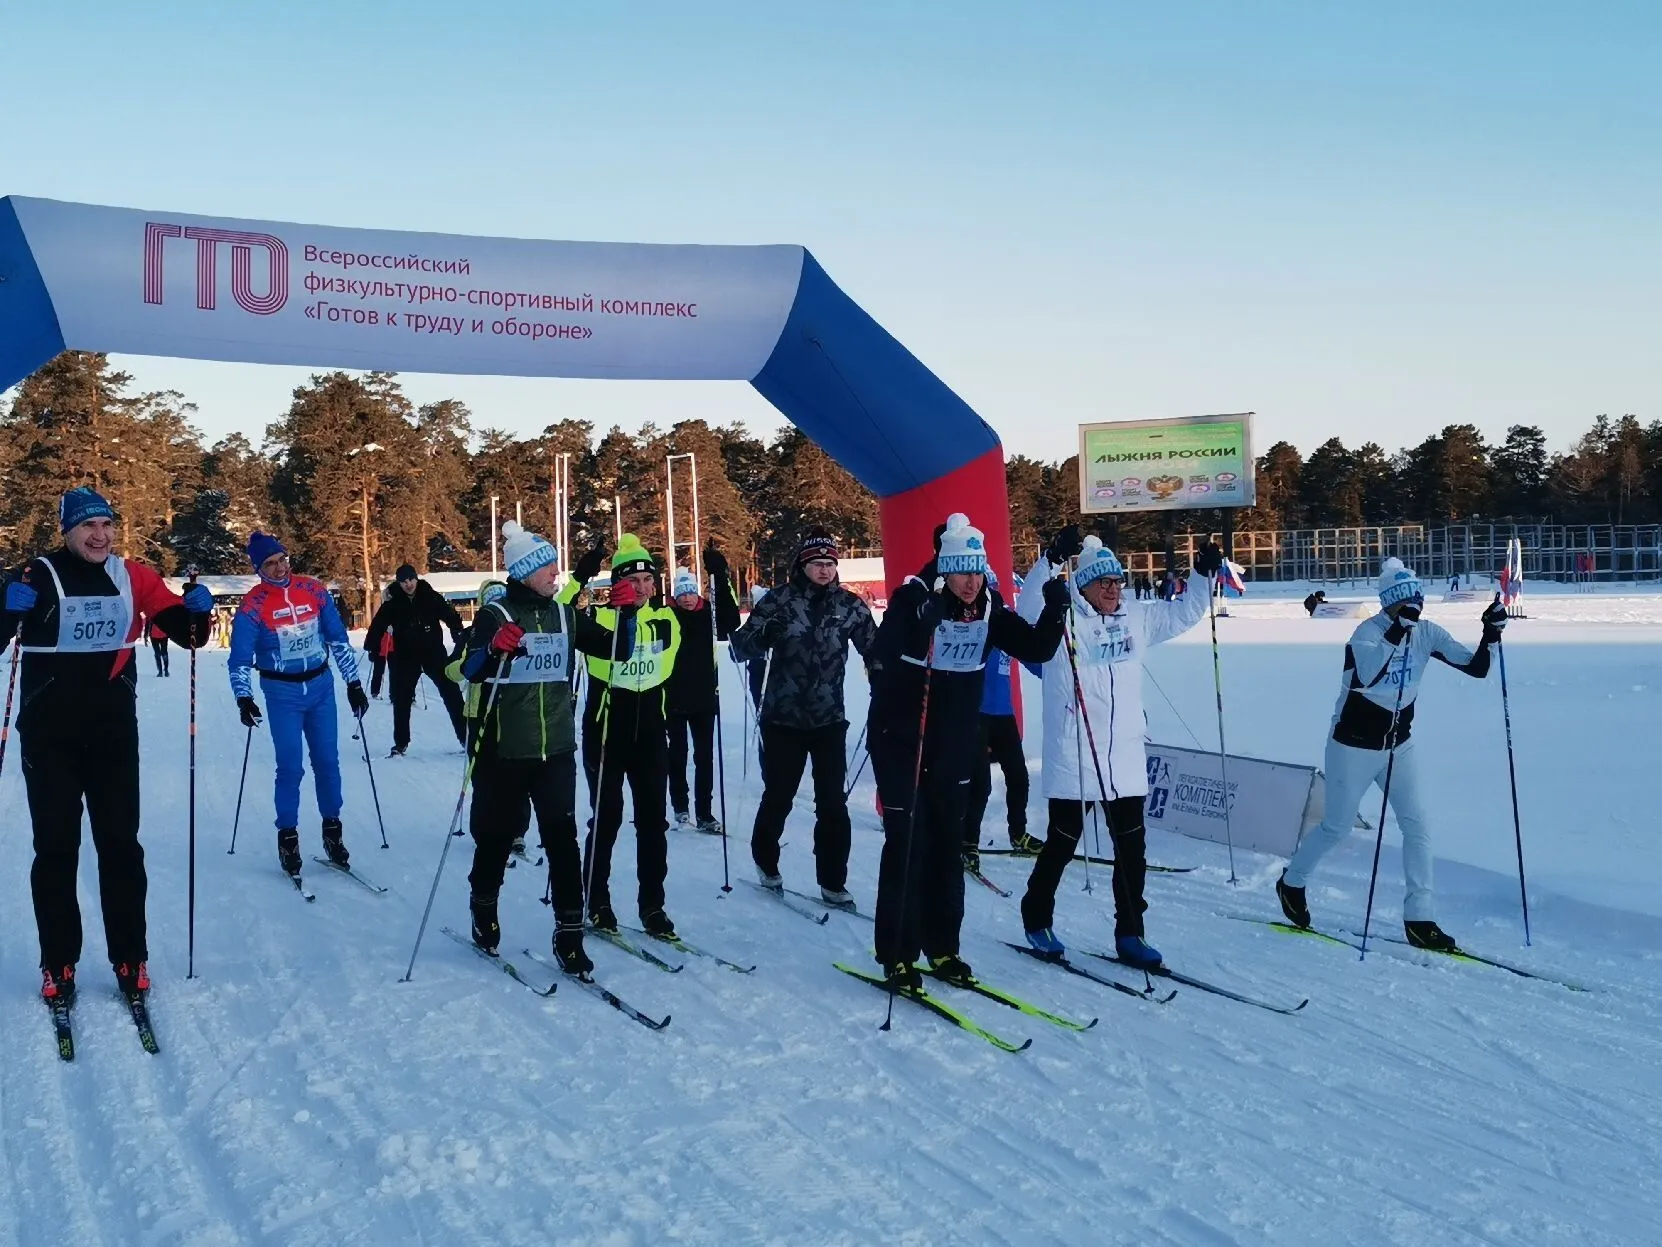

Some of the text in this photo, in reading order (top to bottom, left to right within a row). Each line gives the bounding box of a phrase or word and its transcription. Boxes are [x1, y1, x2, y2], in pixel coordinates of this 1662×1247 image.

[144, 222, 289, 314] ГТО
[304, 245, 470, 275] Всероссийский
[304, 271, 698, 318] физкультурно-спортивный комплекс
[304, 301, 593, 340] «Готов к труду и обороне»
[1095, 447, 1236, 464] ЛЫЖНЯ РОССИИ
[73, 619, 117, 641] 5073
[288, 633, 315, 653] 2567
[941, 642, 979, 660] 7177
[1100, 639, 1131, 659] 7174
[525, 652, 562, 671] 7080
[619, 659, 655, 676] 2000
